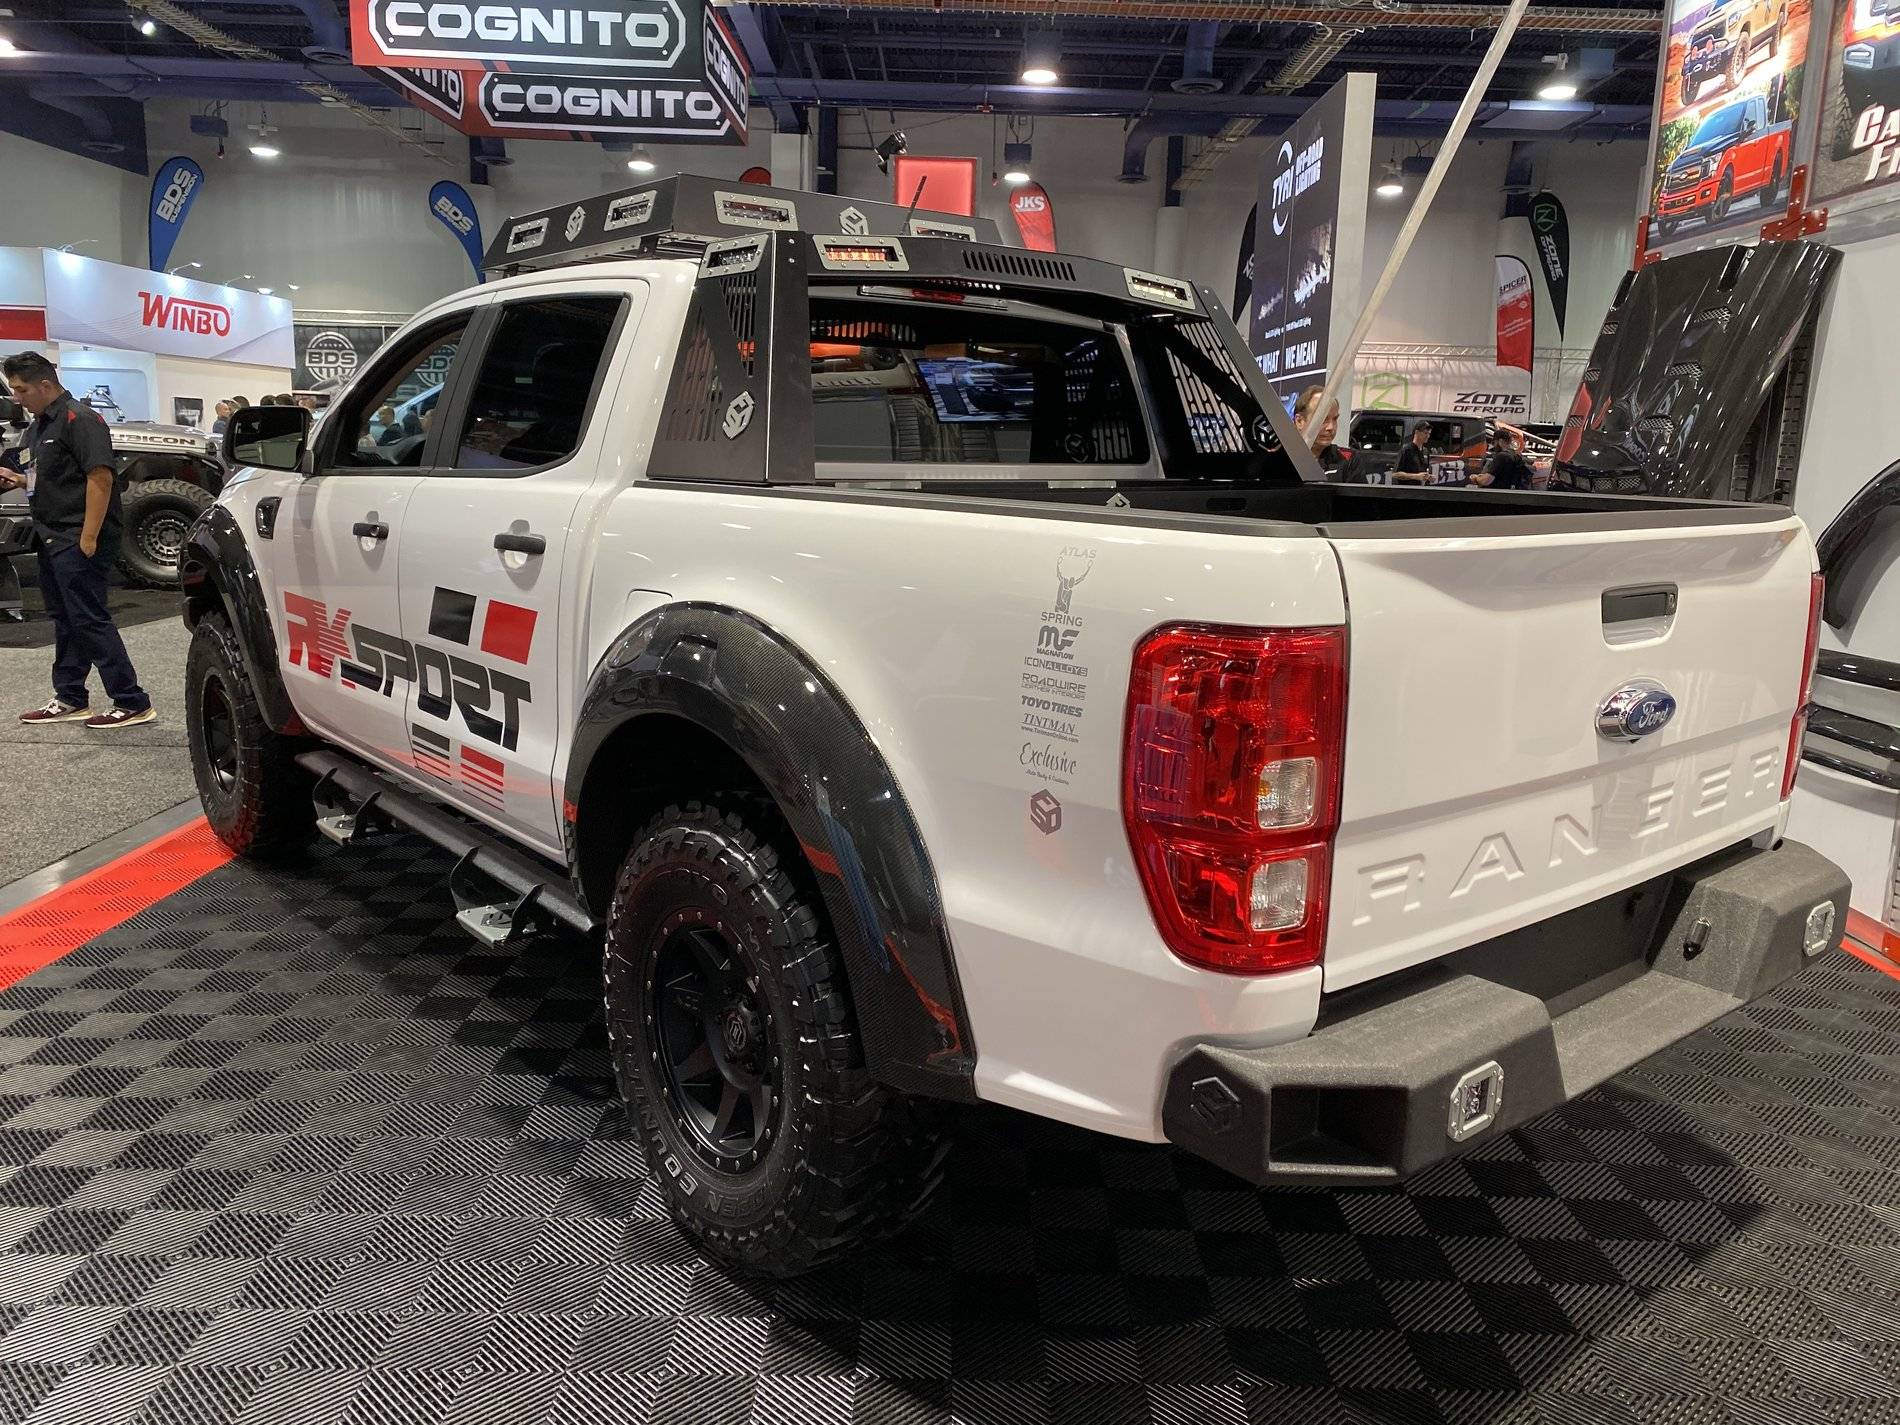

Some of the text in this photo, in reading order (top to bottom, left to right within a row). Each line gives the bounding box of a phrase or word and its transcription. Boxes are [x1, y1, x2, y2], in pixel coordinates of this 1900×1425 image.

[385, 2, 669, 48] COGNITO
[707, 26, 746, 115] COGNITO
[491, 83, 722, 120] COGNITO
[156, 167, 191, 221] BDS
[1272, 165, 1295, 210] TYRI
[436, 195, 474, 231] BDS
[1015, 195, 1045, 211] JKS
[1544, 234, 1564, 280] ZONE
[137, 291, 231, 337] WINBO
[308, 350, 356, 366] BDS
[1295, 340, 1318, 368] MEAN
[1453, 390, 1527, 405] ZONE
[1453, 405, 1526, 415] OFFROAD
[111, 433, 196, 446] UBICON
[1059, 545, 1097, 559] ATLAS
[1040, 611, 1083, 627] SPRING
[1036, 647, 1075, 661] MAGNAFLOW
[1021, 672, 1087, 694] ROADWIRE
[1022, 712, 1077, 735] TINTMAN
[1638, 700, 1670, 729] Ford
[1019, 742, 1078, 775] Exclusive
[1351, 745, 1780, 927] RANGER
